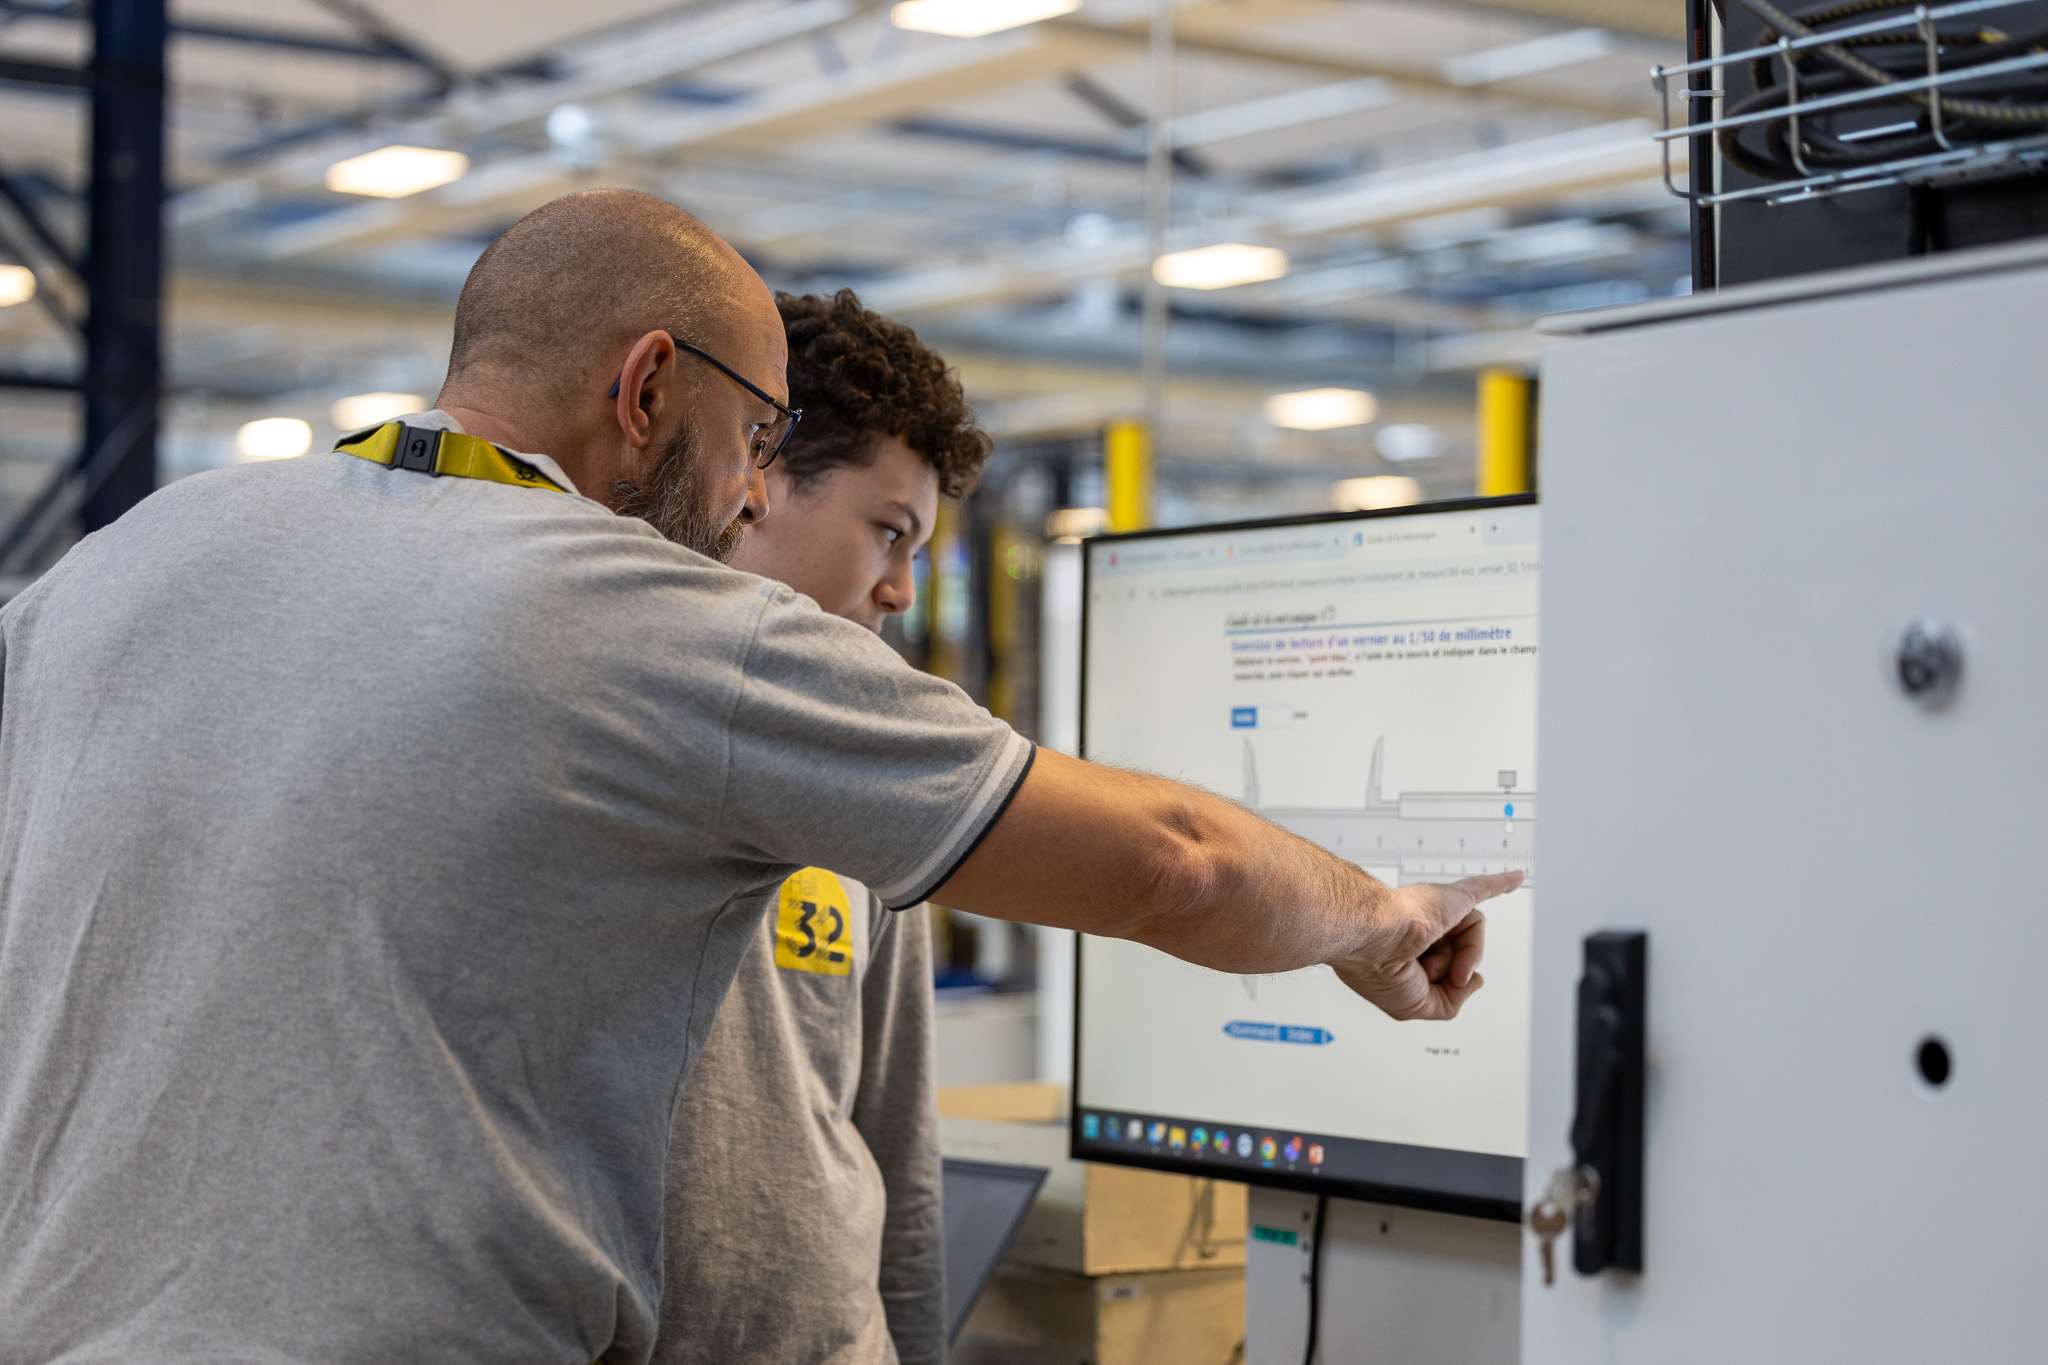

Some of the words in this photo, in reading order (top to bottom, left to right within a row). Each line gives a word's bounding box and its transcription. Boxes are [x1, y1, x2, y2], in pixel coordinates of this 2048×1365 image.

[514, 469, 538, 484] 32
[1439, 629, 1451, 642] de
[1455, 626, 1513, 641] millimètre
[1510, 643, 1537, 657] champ
[785, 898, 845, 964] 32
